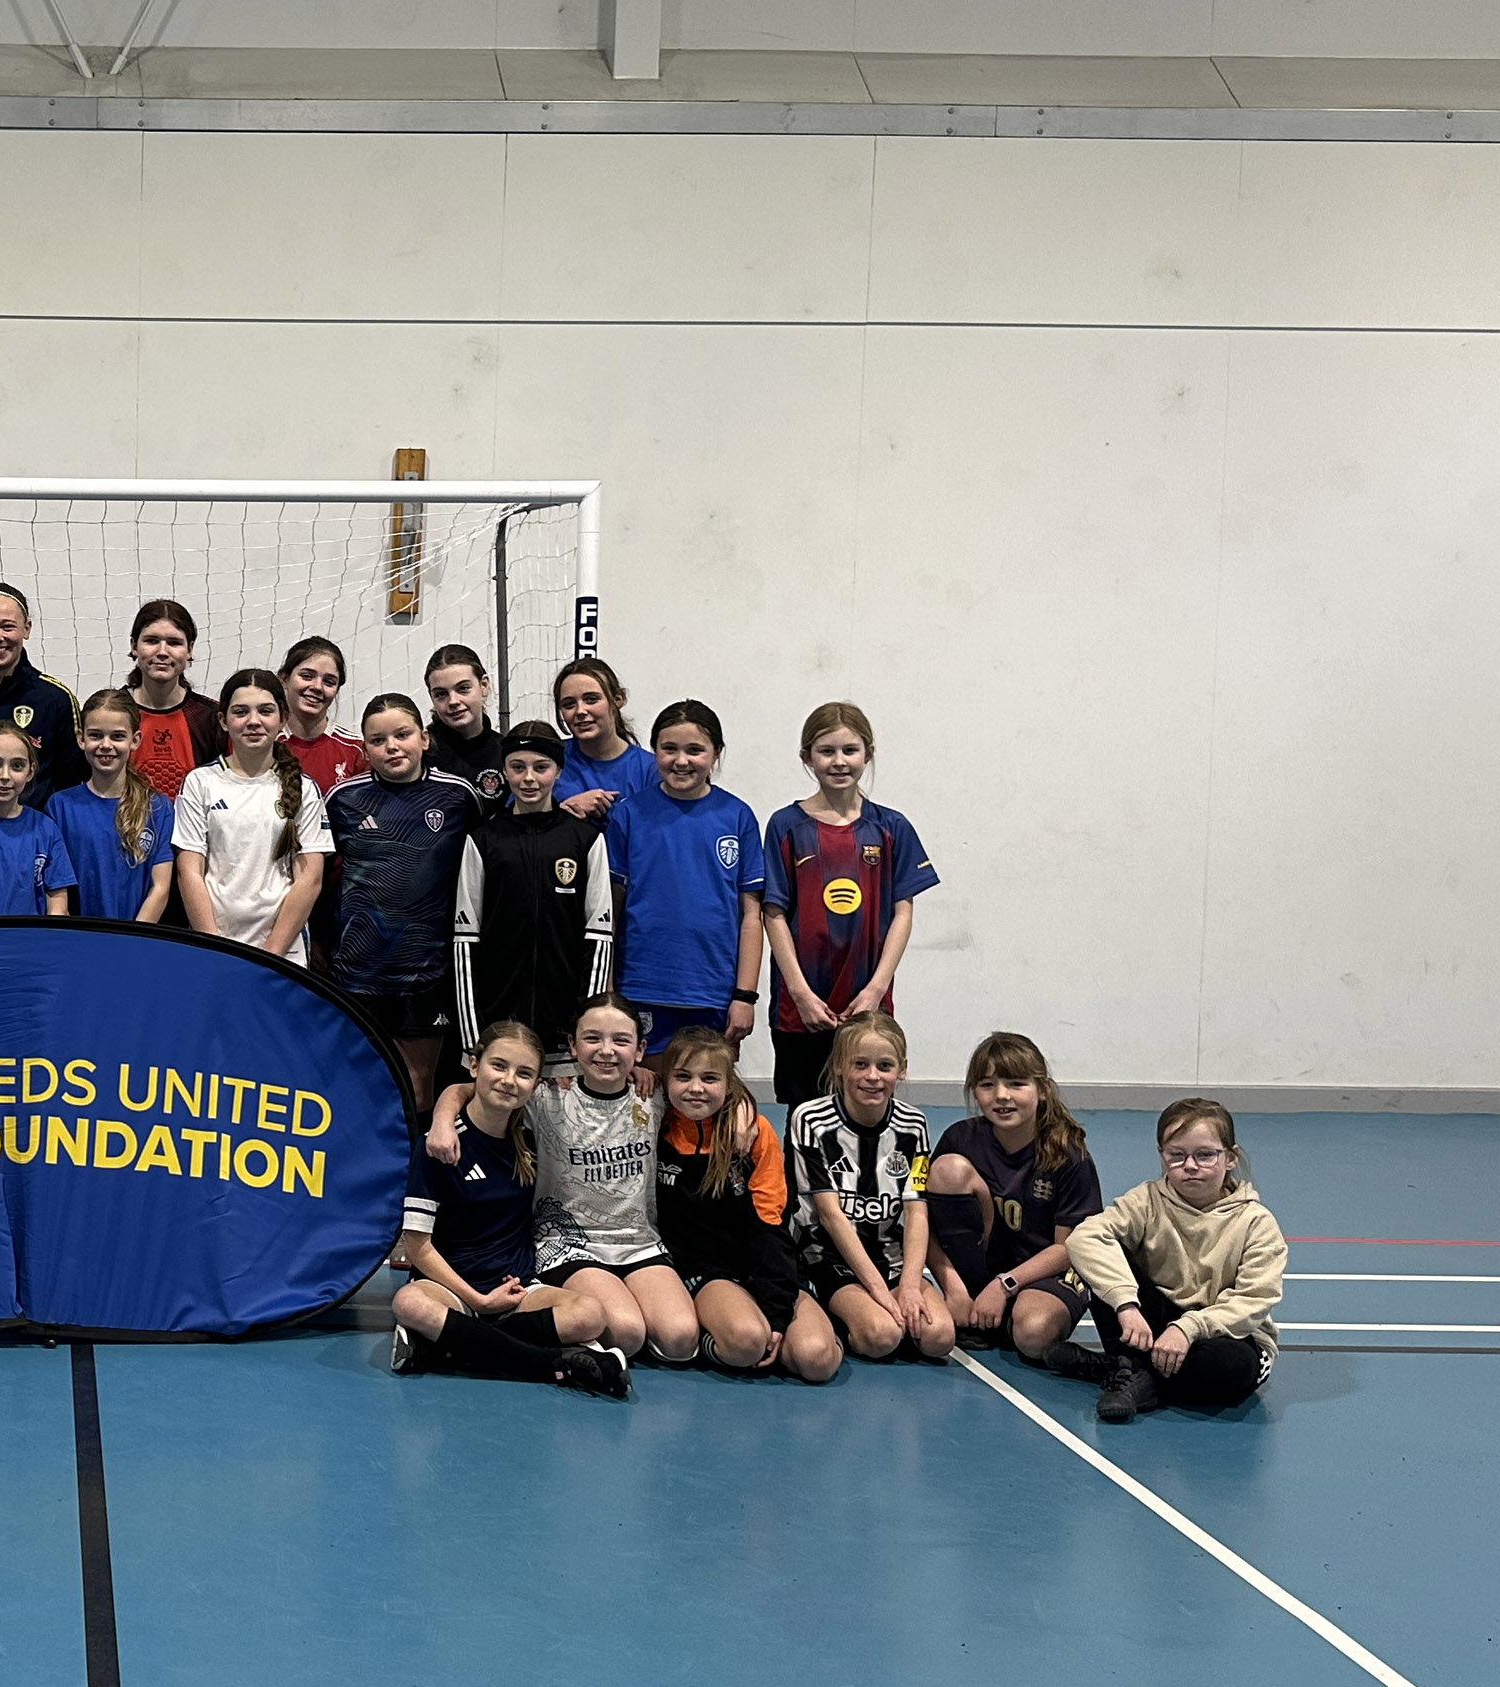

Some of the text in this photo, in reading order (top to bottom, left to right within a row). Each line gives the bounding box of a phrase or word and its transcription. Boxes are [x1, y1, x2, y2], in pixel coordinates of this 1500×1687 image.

[118, 1063, 332, 1137] UNITED
[568, 1140, 652, 1166] Emirates
[584, 1160, 644, 1182] FLY BETTER
